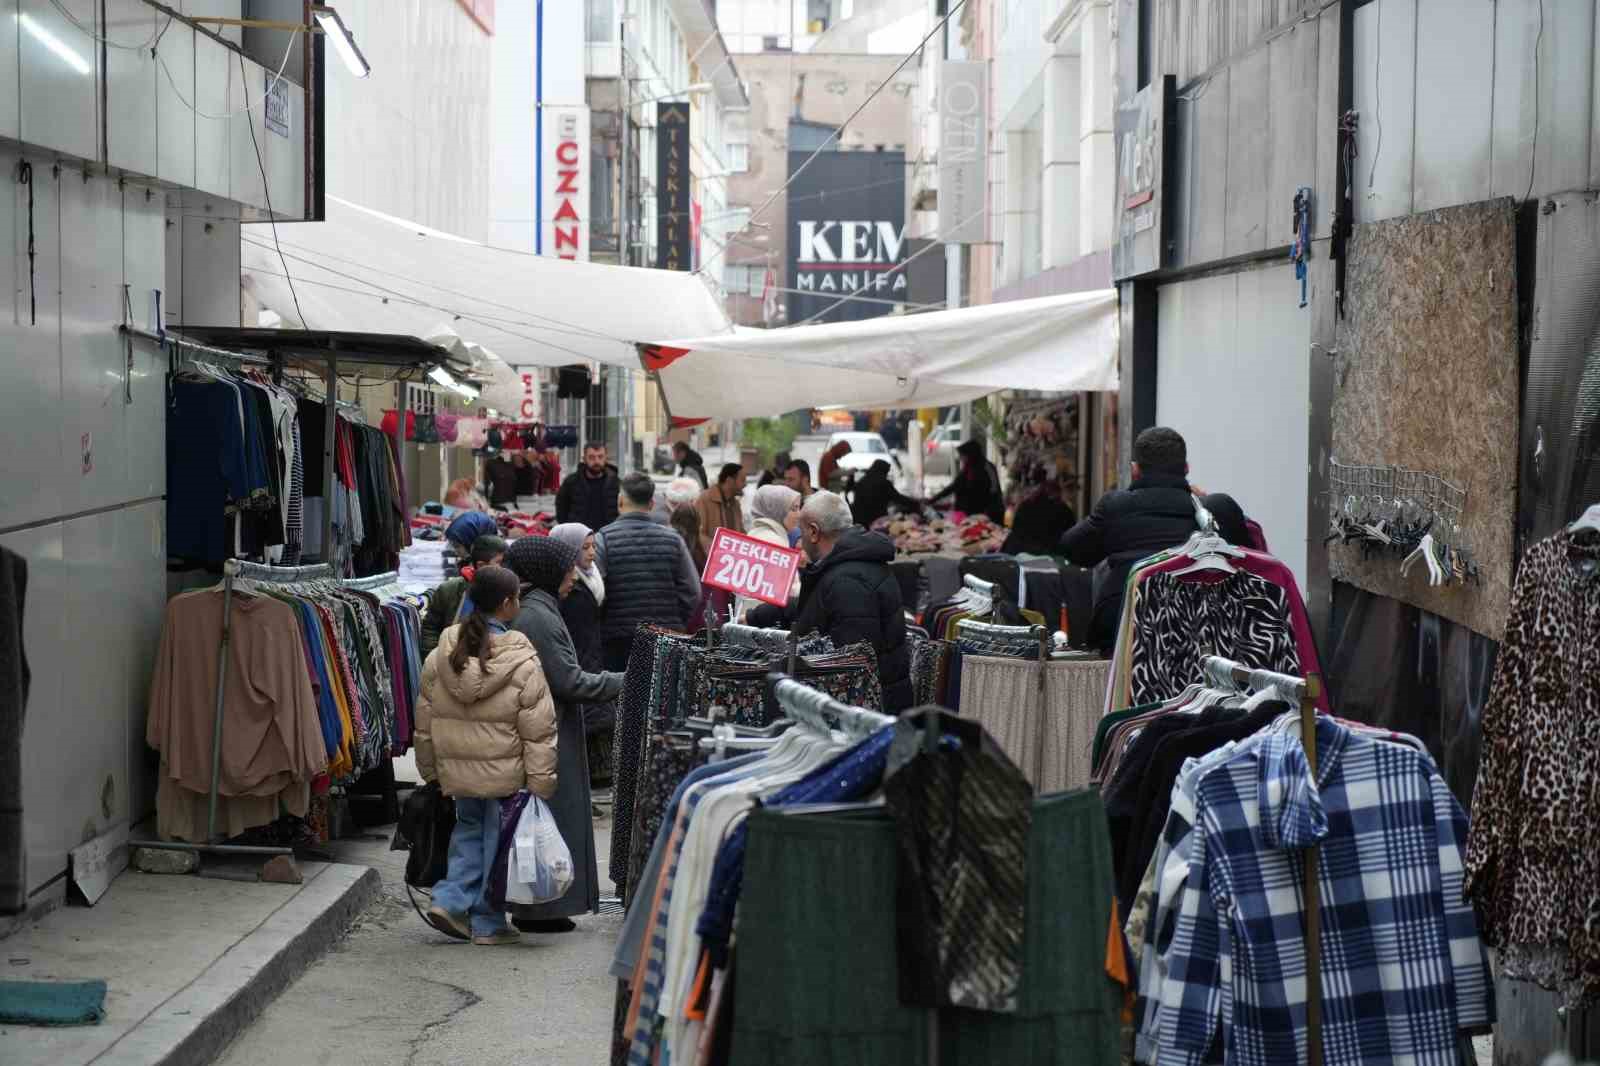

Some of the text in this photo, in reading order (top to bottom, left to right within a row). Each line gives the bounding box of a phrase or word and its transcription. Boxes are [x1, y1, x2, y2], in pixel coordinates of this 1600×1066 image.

[719, 535, 789, 568] ETEKLER
[714, 554, 775, 597] 200 TL
